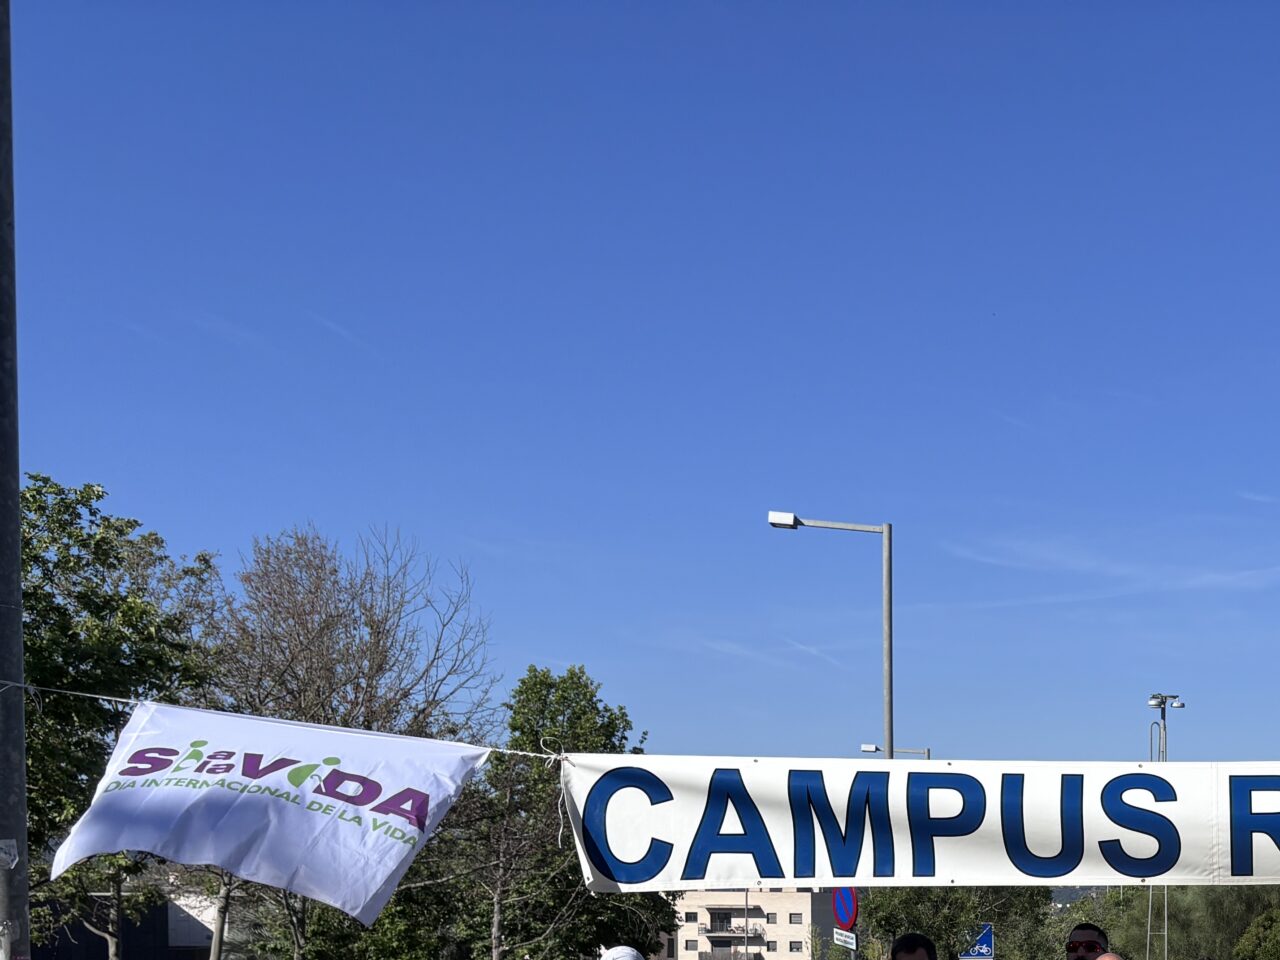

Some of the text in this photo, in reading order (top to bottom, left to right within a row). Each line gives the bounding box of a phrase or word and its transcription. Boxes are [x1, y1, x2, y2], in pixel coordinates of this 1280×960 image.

[140, 777, 301, 806] INTERNACIONAL
[306, 800, 333, 817] DE
[337, 809, 363, 828] LA
[371, 817, 419, 847] VIDA
[582, 766, 1182, 884] CAMPUS
